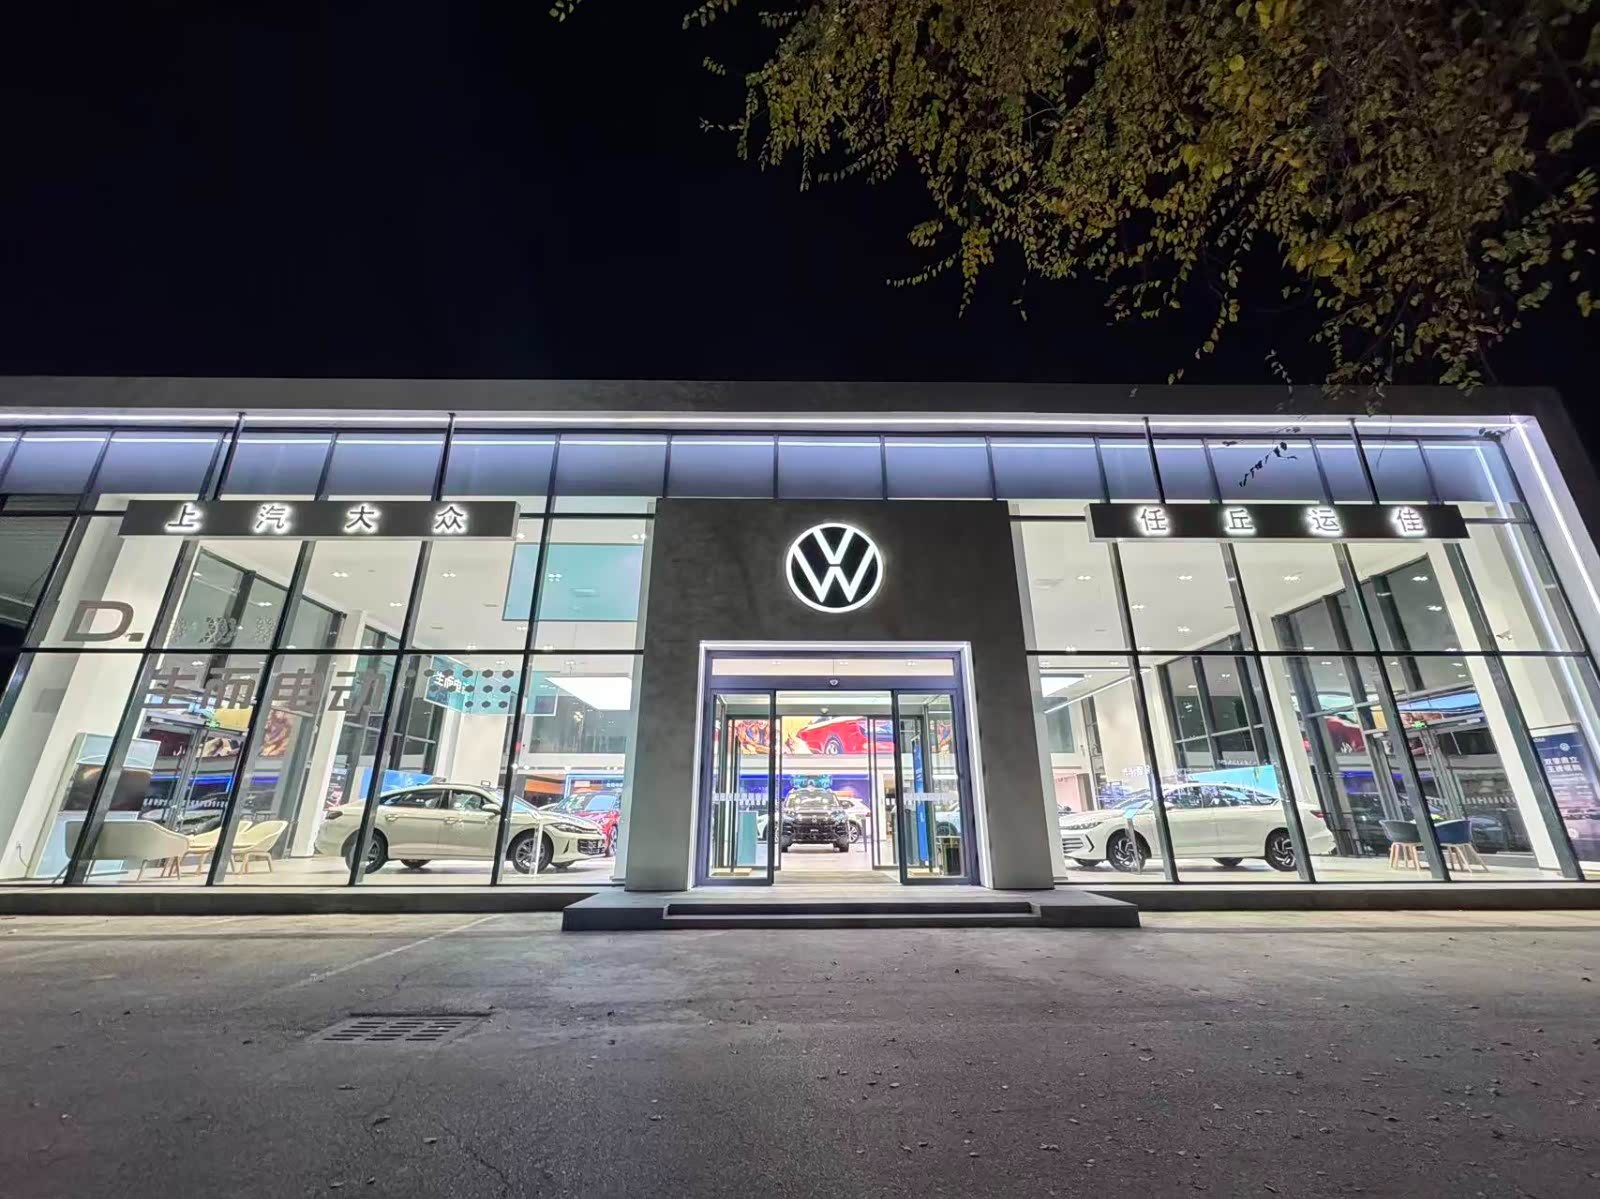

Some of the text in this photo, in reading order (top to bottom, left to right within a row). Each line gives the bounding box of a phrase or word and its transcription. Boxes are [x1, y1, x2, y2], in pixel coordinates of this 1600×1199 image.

[166, 503, 468, 533] 上汽大众
[1138, 505, 1428, 533] 任丘运佳
